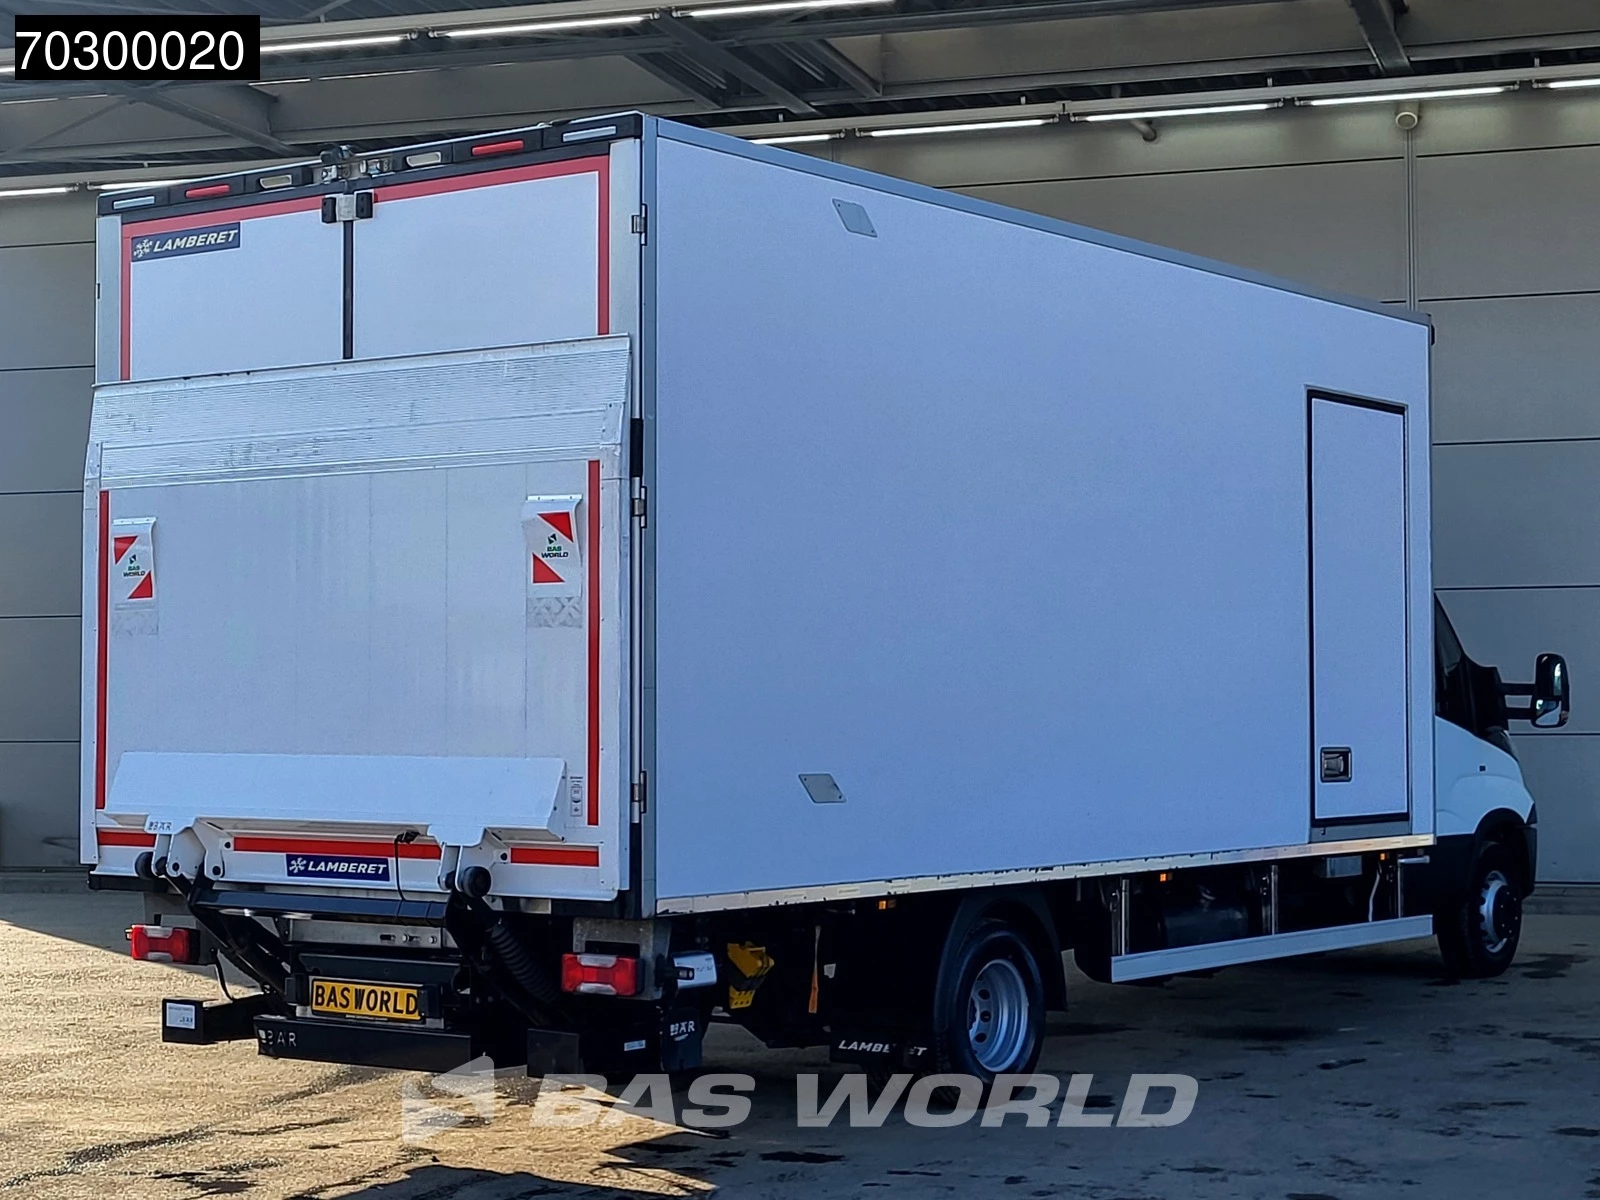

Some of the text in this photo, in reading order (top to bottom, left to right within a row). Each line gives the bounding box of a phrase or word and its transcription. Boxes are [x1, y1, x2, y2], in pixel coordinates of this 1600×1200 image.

[153, 229, 239, 252] LAMBERET
[307, 860, 387, 875] LAMBERET
[314, 984, 418, 1015] BAS WORLD
